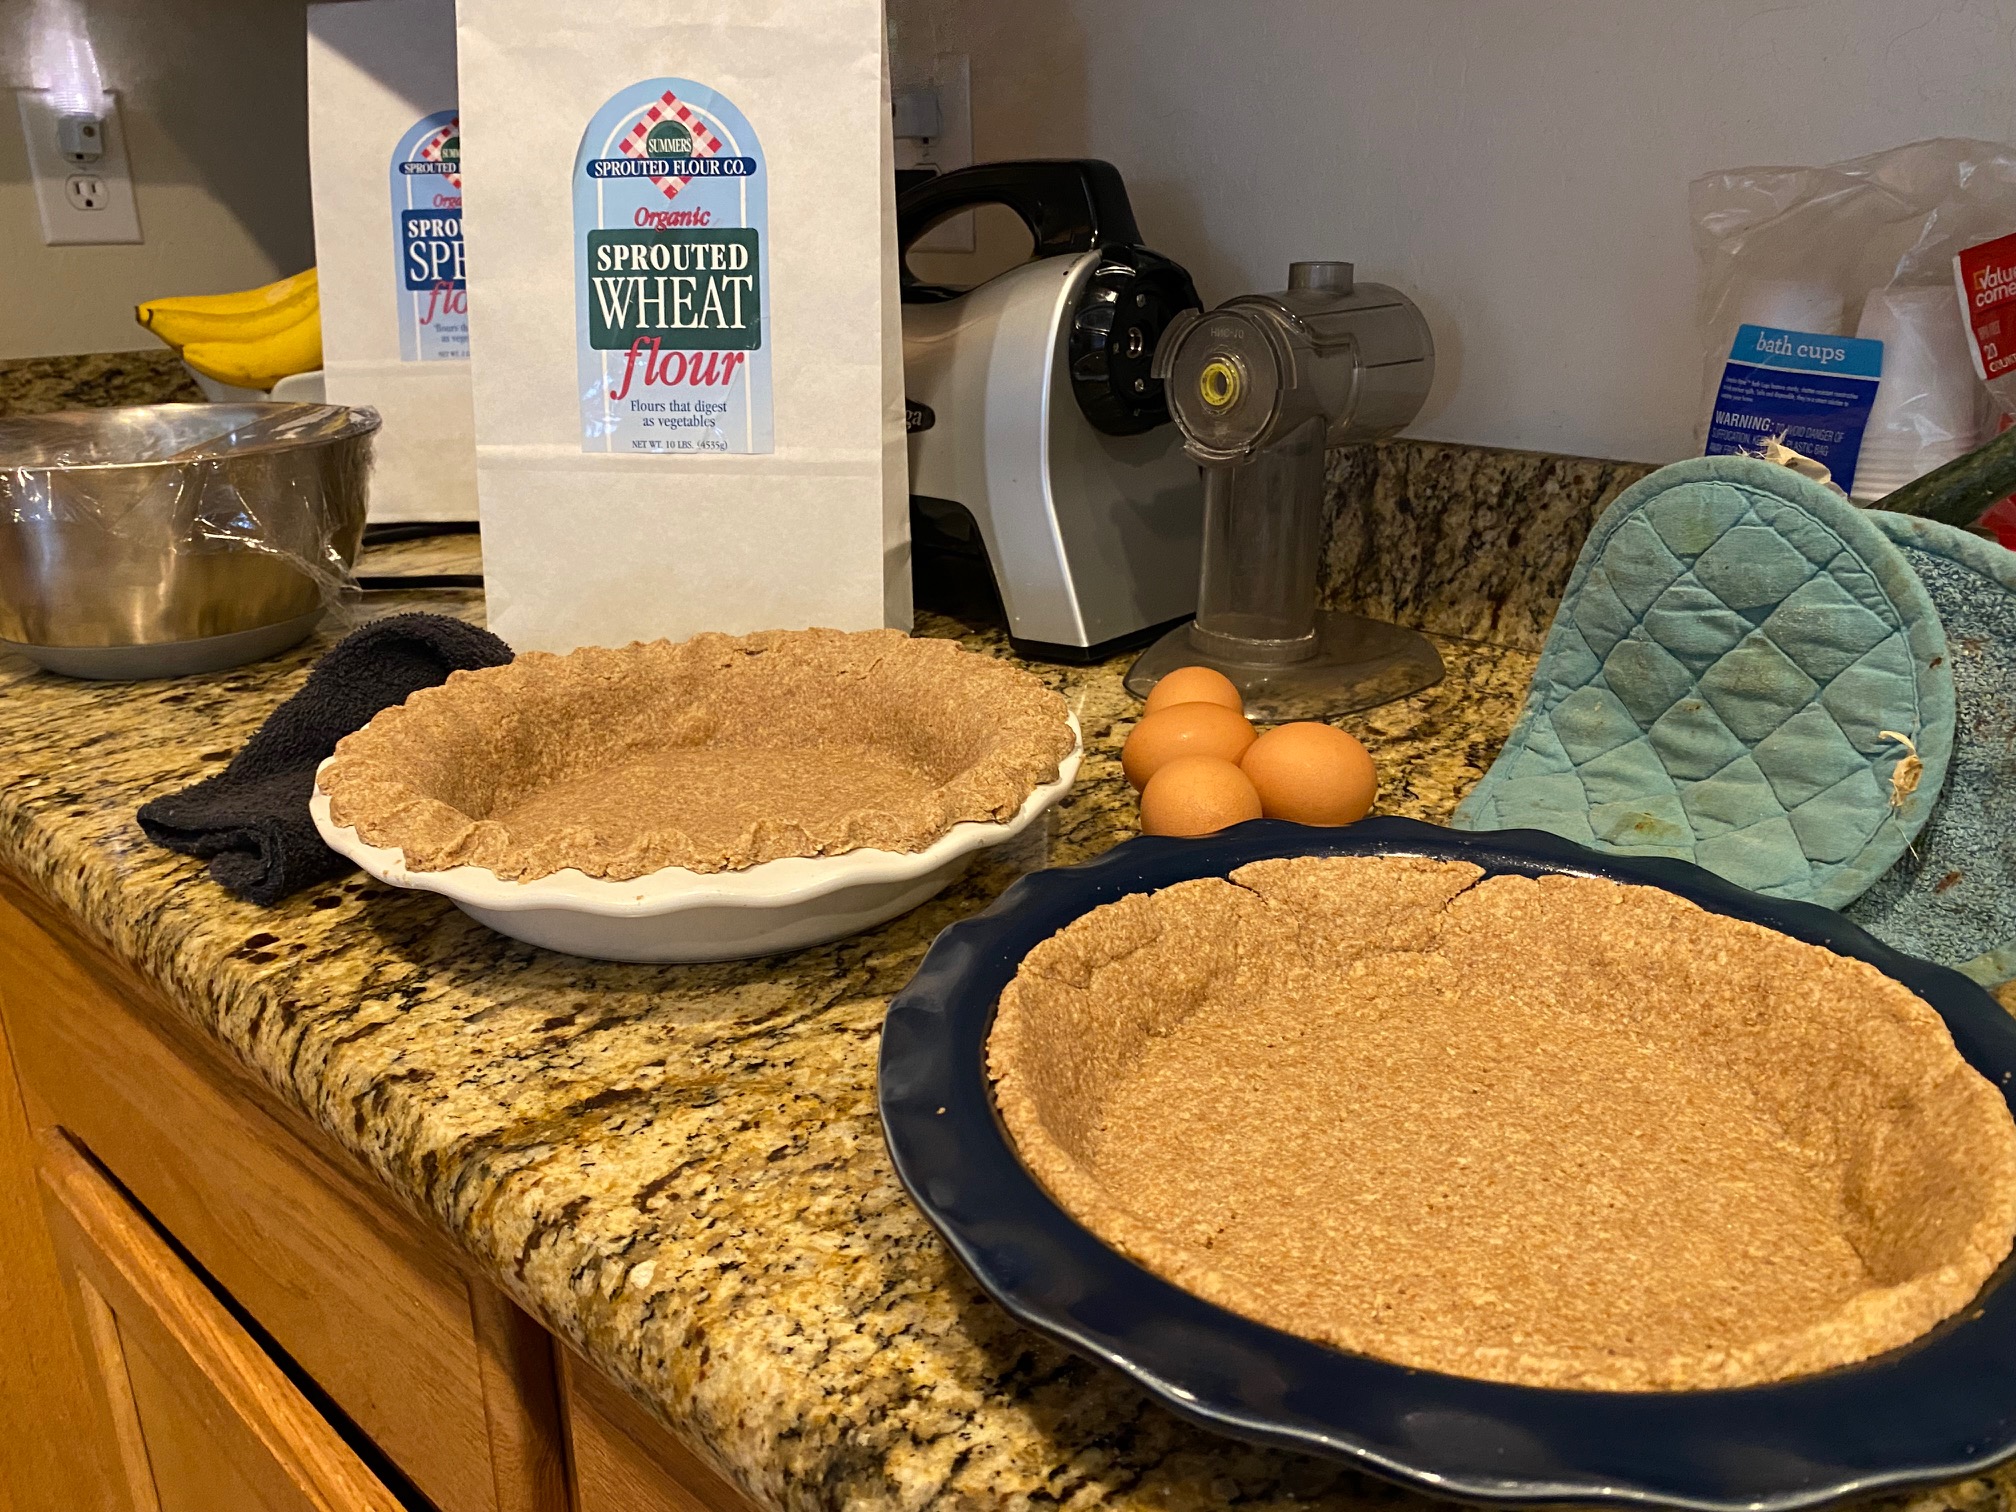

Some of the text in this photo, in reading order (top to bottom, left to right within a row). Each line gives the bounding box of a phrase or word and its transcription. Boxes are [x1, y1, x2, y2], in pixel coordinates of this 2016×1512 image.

[648, 138, 692, 153] SUMMERS
[404, 163, 457, 174] SPROUTED
[594, 159, 747, 177] SPROUTED FLOUR CO.
[634, 206, 711, 232] Organic
[596, 243, 749, 271] SPROUTED
[592, 275, 753, 330] WHEAT
[1756, 331, 1846, 364] bath cups
[609, 336, 745, 401] flour
[631, 400, 727, 415] Flours that digest
[643, 415, 716, 430] as vegetables
[1715, 410, 1773, 433] WARNING:
[632, 441, 647, 449] NET
[666, 441, 676, 449] 10
[677, 441, 694, 449] LBS.
